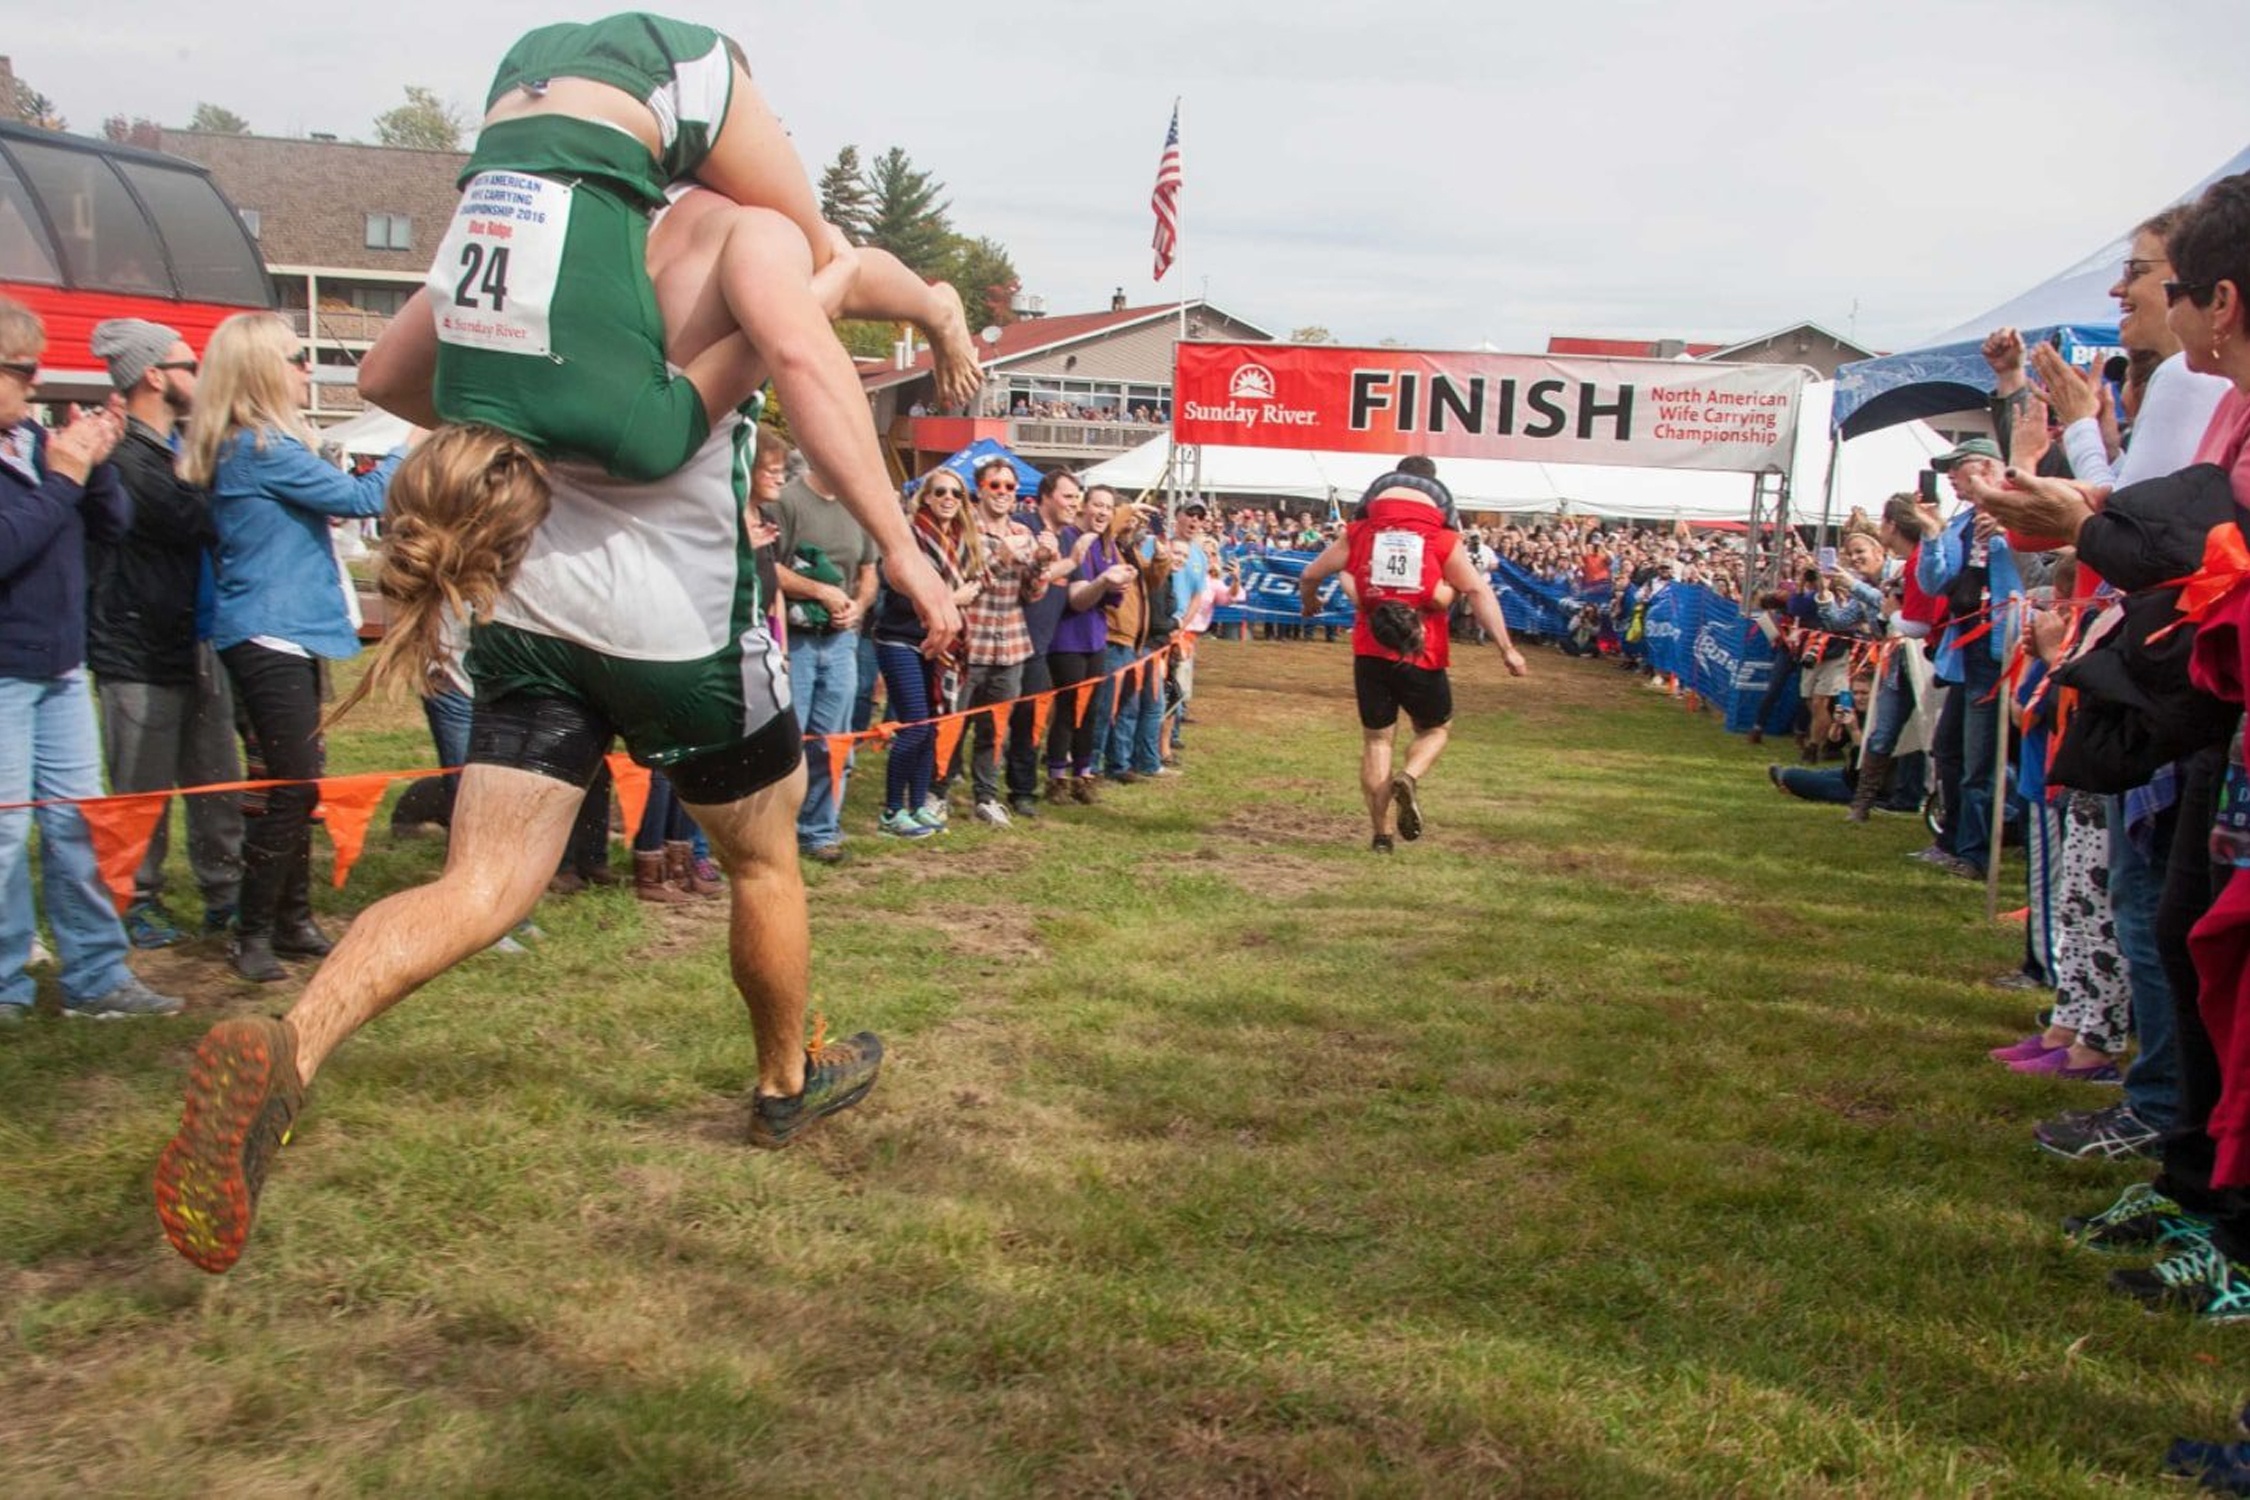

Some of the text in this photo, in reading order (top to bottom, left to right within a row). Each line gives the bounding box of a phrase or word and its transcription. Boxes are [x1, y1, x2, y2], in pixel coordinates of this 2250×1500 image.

[490, 175, 542, 191] AMERICAN
[484, 189, 533, 205] CARRYING
[516, 208, 546, 223] 2016
[455, 242, 510, 312] 24
[455, 318, 527, 338] Sunday River
[1349, 371, 1635, 441] FINISH
[1651, 387, 1787, 406] North American
[1184, 400, 1259, 428] Sunday
[1660, 406, 1776, 429] Wife Carrying
[1654, 423, 1777, 446] Championship
[1386, 555, 1407, 575] 43
